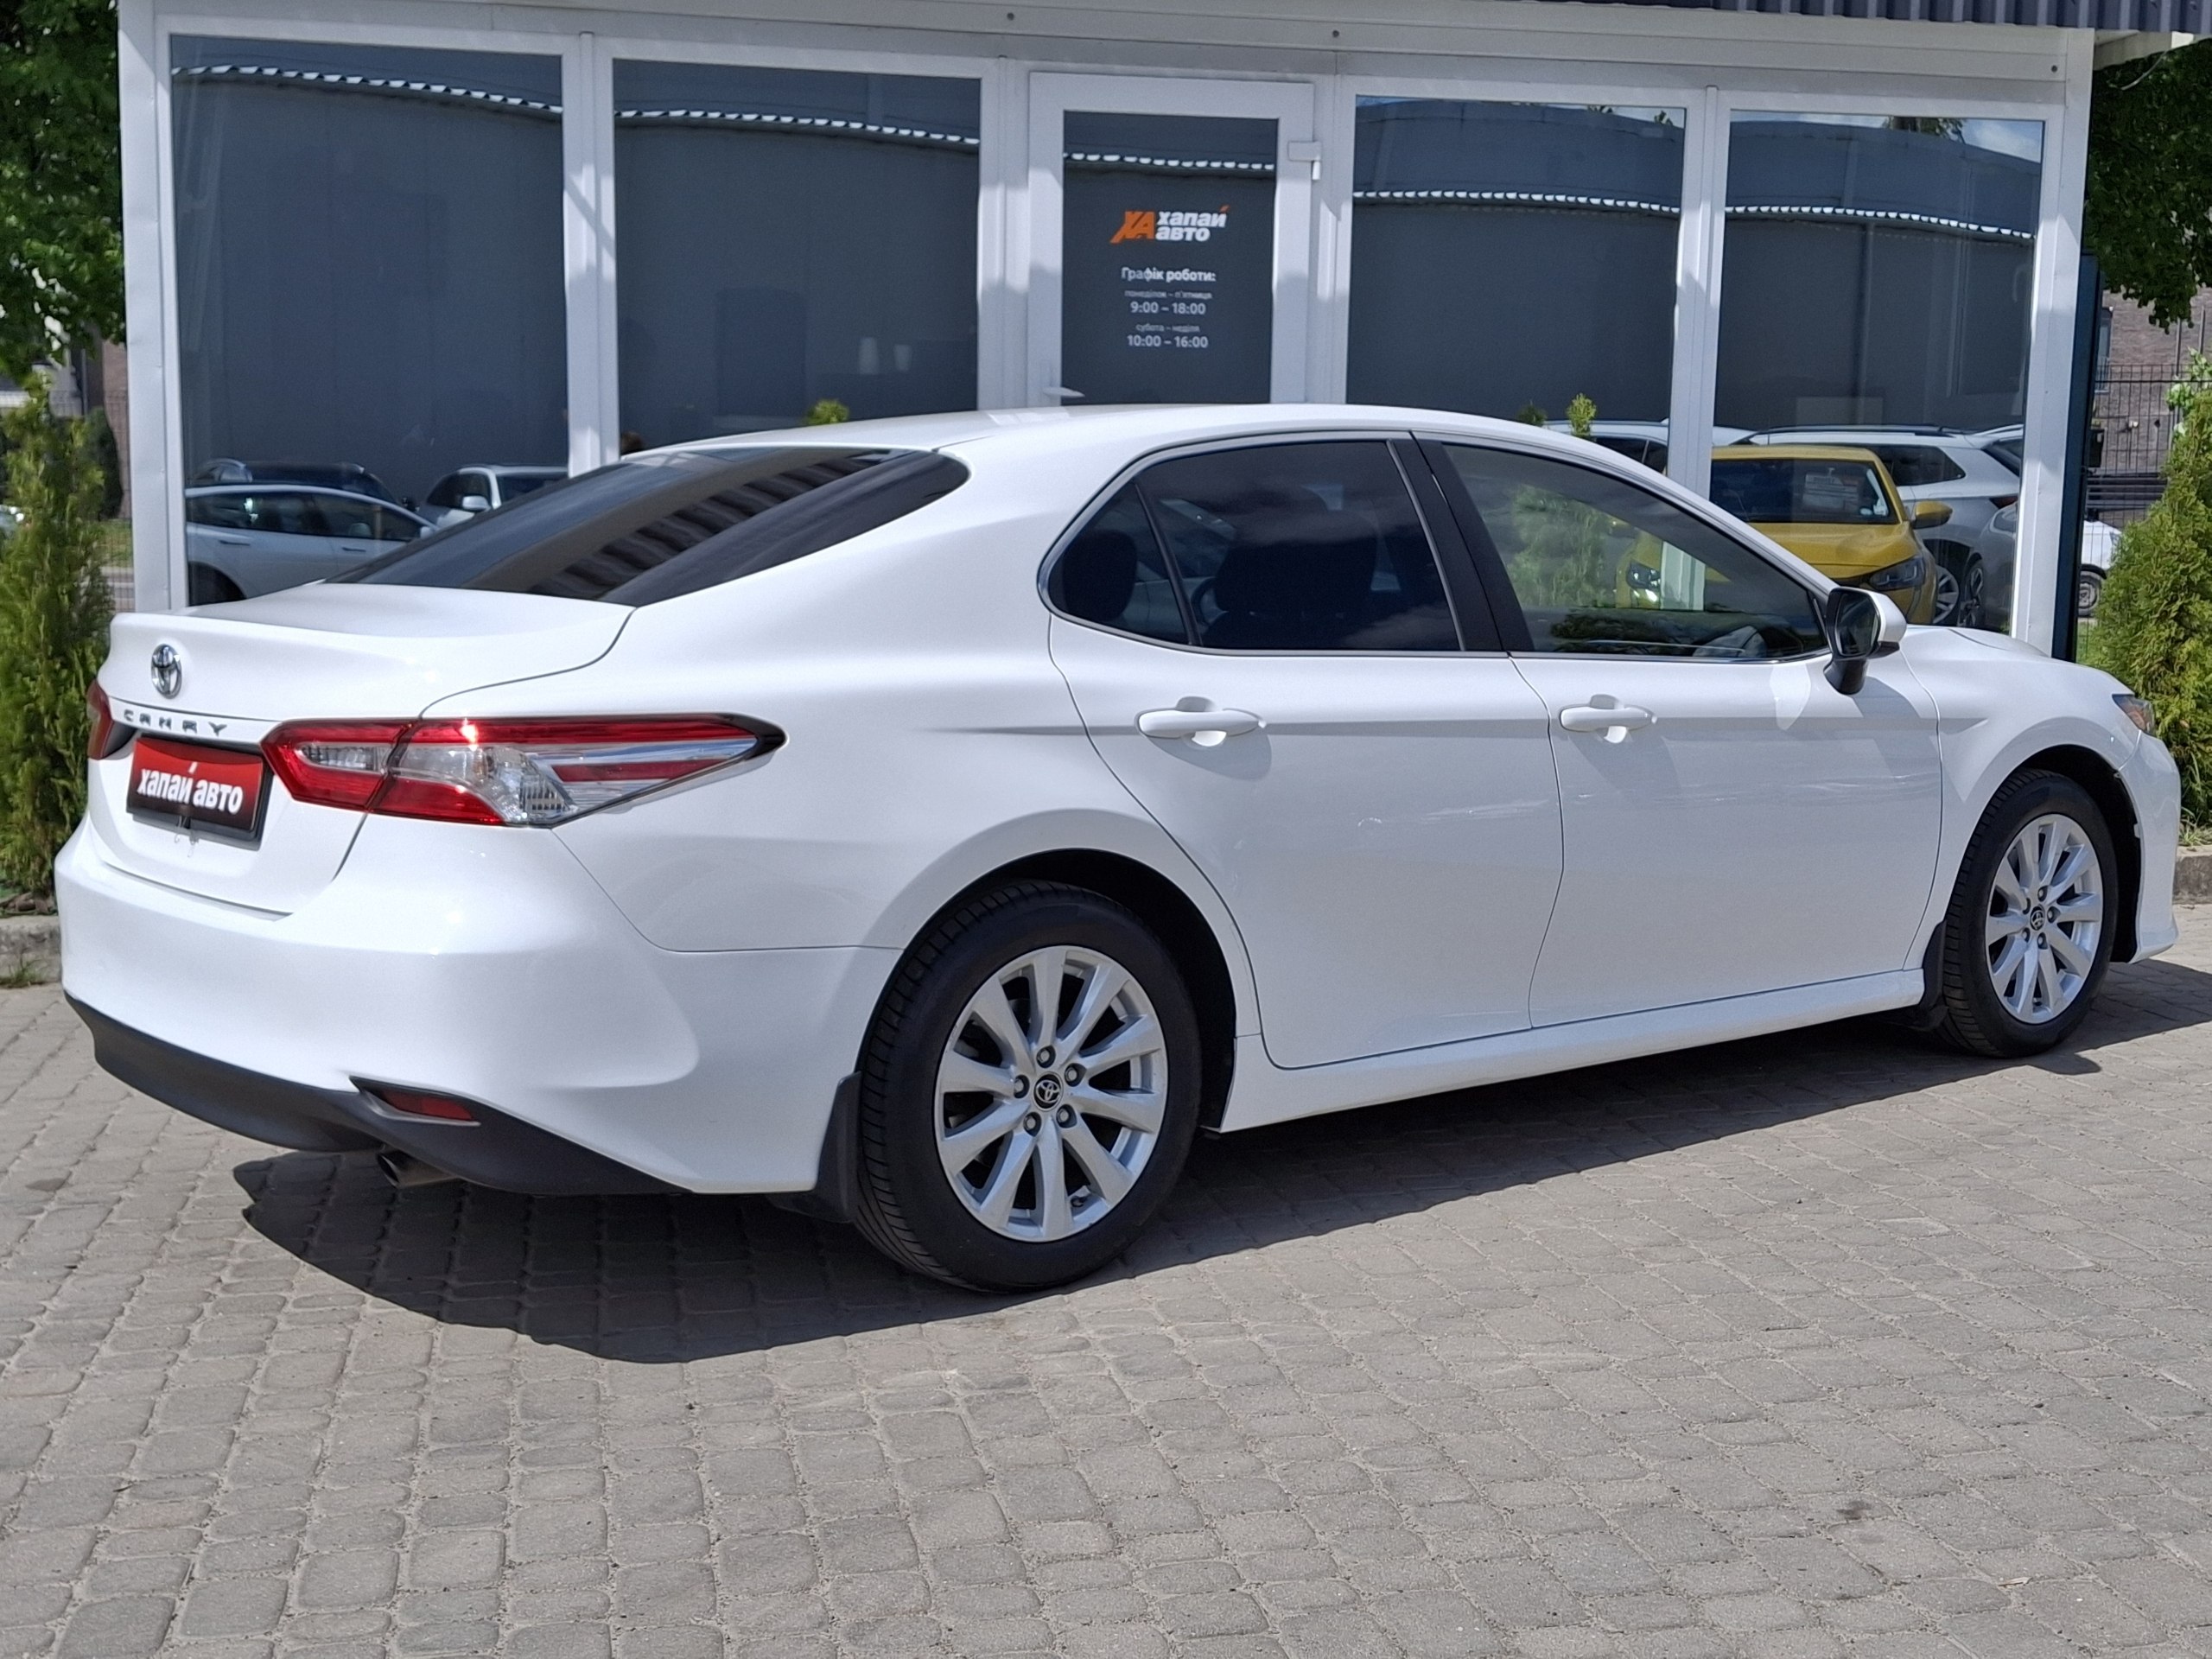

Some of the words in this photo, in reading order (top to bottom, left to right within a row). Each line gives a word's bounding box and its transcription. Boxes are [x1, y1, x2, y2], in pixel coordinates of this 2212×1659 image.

[1155, 226, 1210, 241] авто
[1122, 267, 1164, 282] Графік
[1166, 269, 1216, 283] роботи:
[1130, 302, 1159, 313] 9:00
[1172, 302, 1206, 315] 18:00
[1127, 334, 1161, 346] 10:00
[1174, 336, 1209, 347] 16:00
[137, 761, 199, 805] хапай
[193, 779, 244, 815] авто
